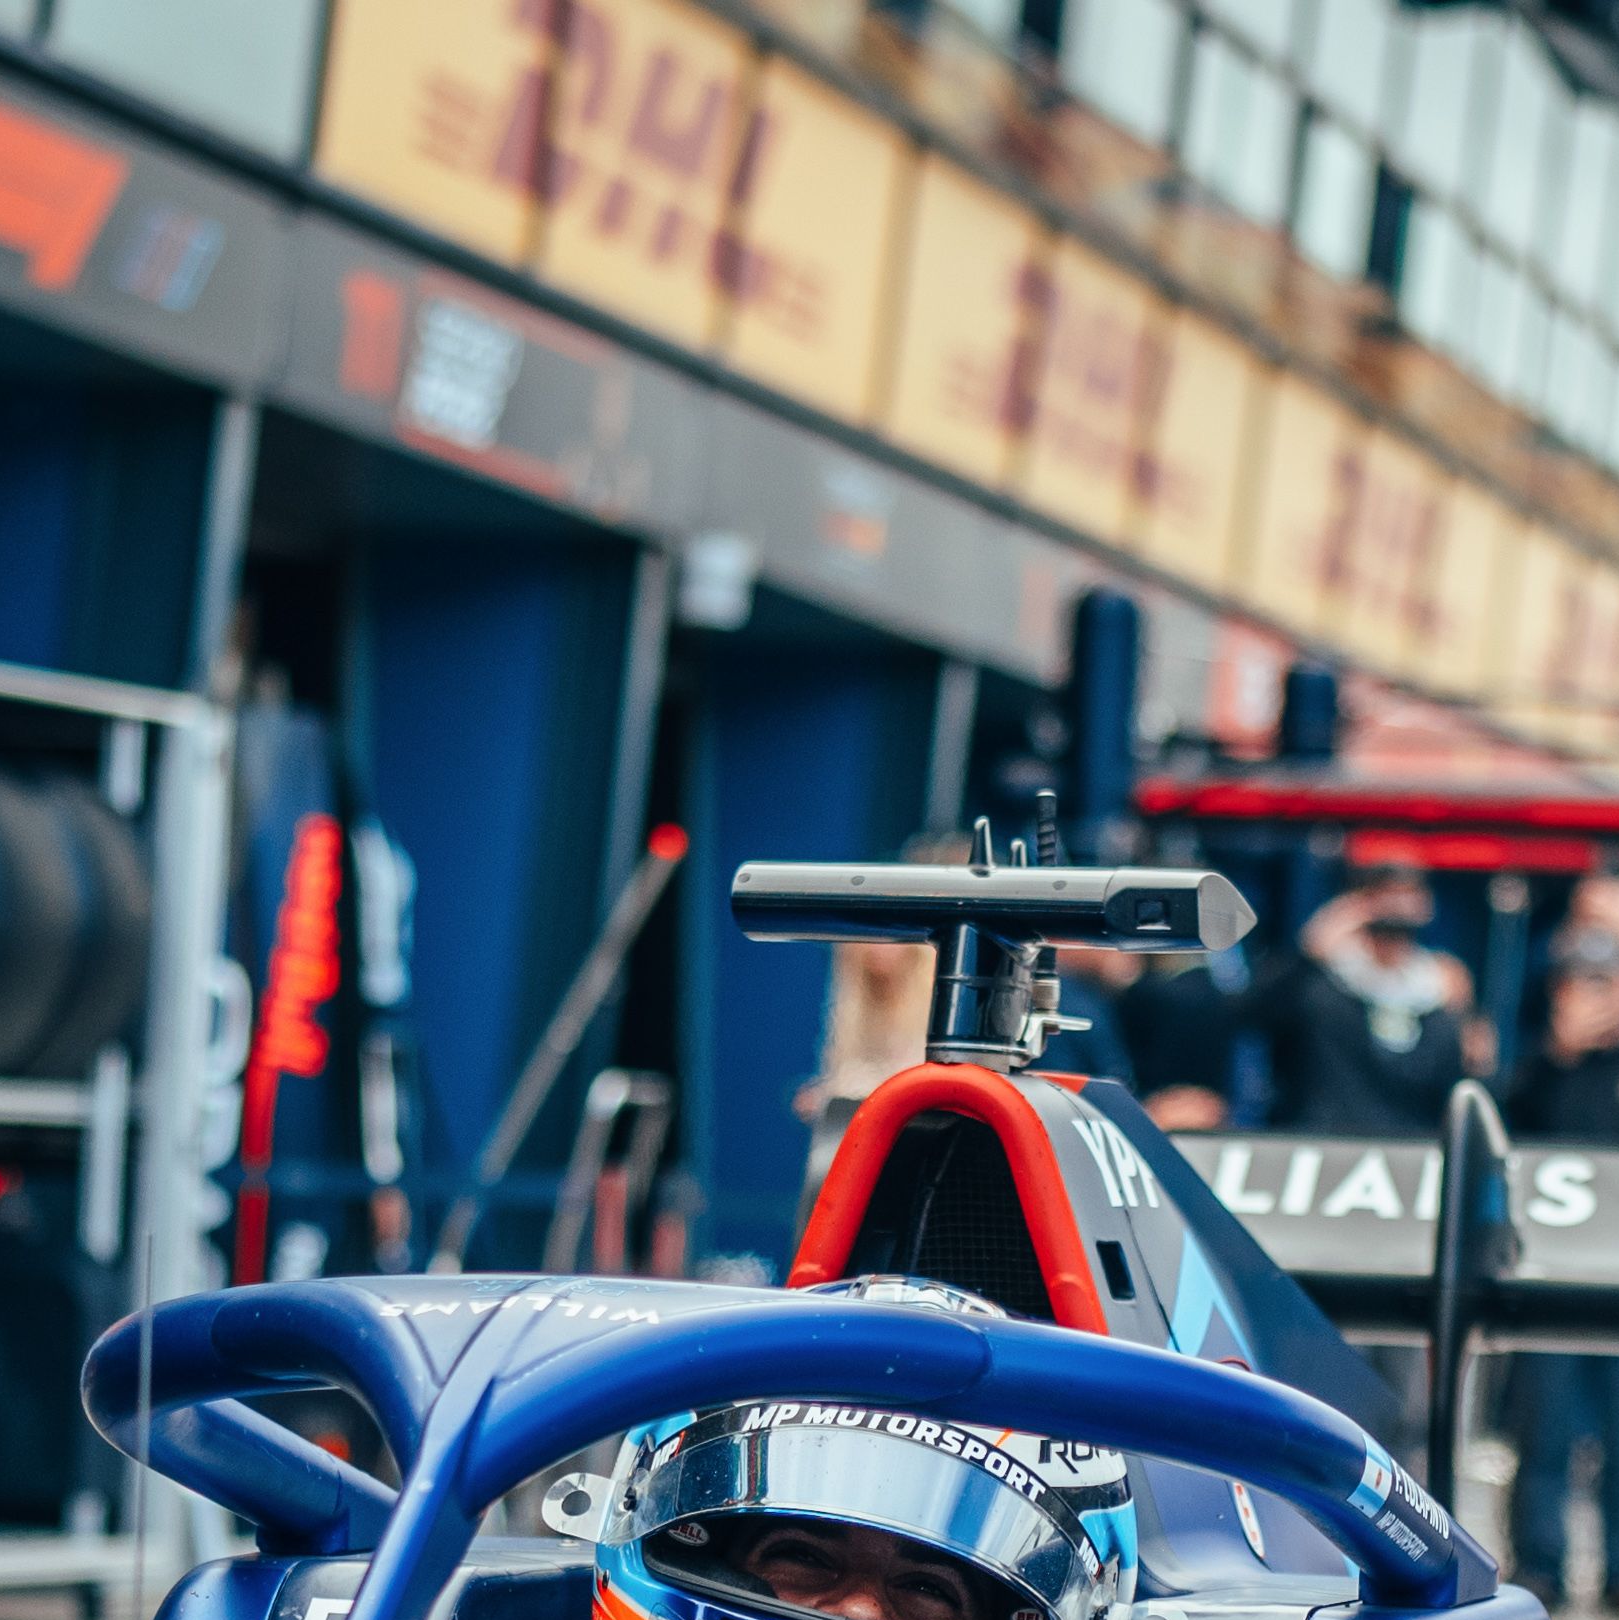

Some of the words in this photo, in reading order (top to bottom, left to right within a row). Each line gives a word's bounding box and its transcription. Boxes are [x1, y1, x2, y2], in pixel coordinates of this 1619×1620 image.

[379, 1294, 661, 1325] WILLIAMS
[741, 1403, 801, 1433] MP
[801, 1405, 1047, 1502] MOTORSPORT
